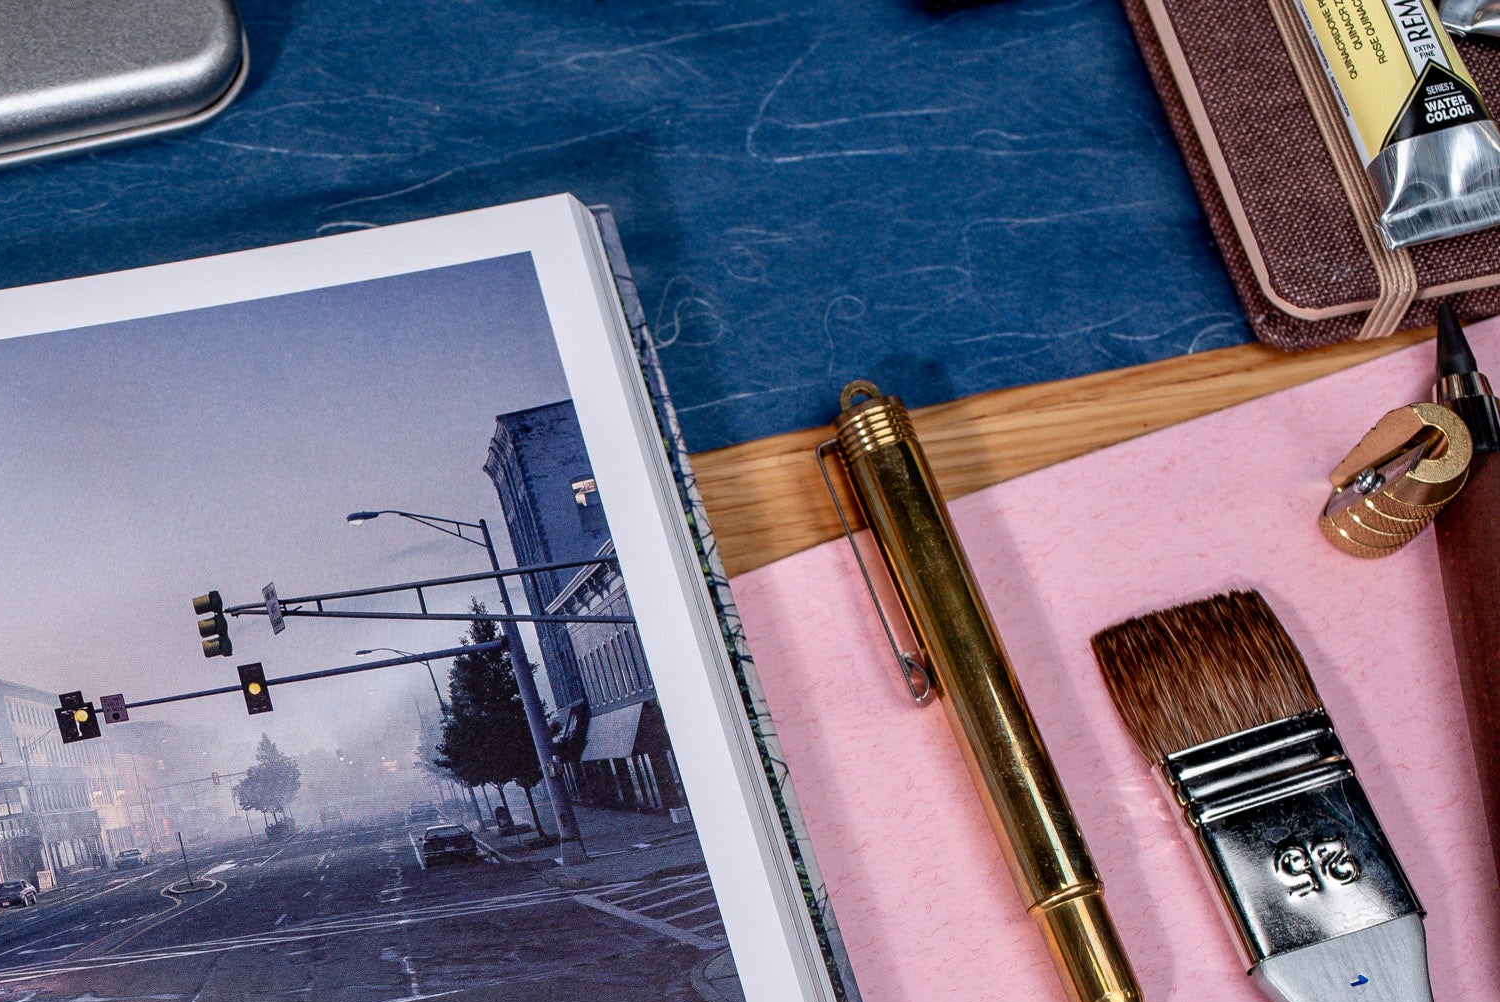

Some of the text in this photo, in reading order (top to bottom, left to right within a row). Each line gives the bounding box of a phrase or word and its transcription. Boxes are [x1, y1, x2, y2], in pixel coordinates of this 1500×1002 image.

[1338, 6, 1363, 50] QUINACR
[1321, 7, 1358, 80] QUINACRIDONE
[1369, 36, 1388, 64] ROSE
[1413, 43, 1436, 53] EXTRA
[1419, 50, 1436, 59] FINE
[1426, 81, 1455, 95] SERIES 2
[1424, 94, 1467, 113] WATER
[1425, 104, 1475, 124] COLOUR
[1350, 974, 1369, 988] 1
